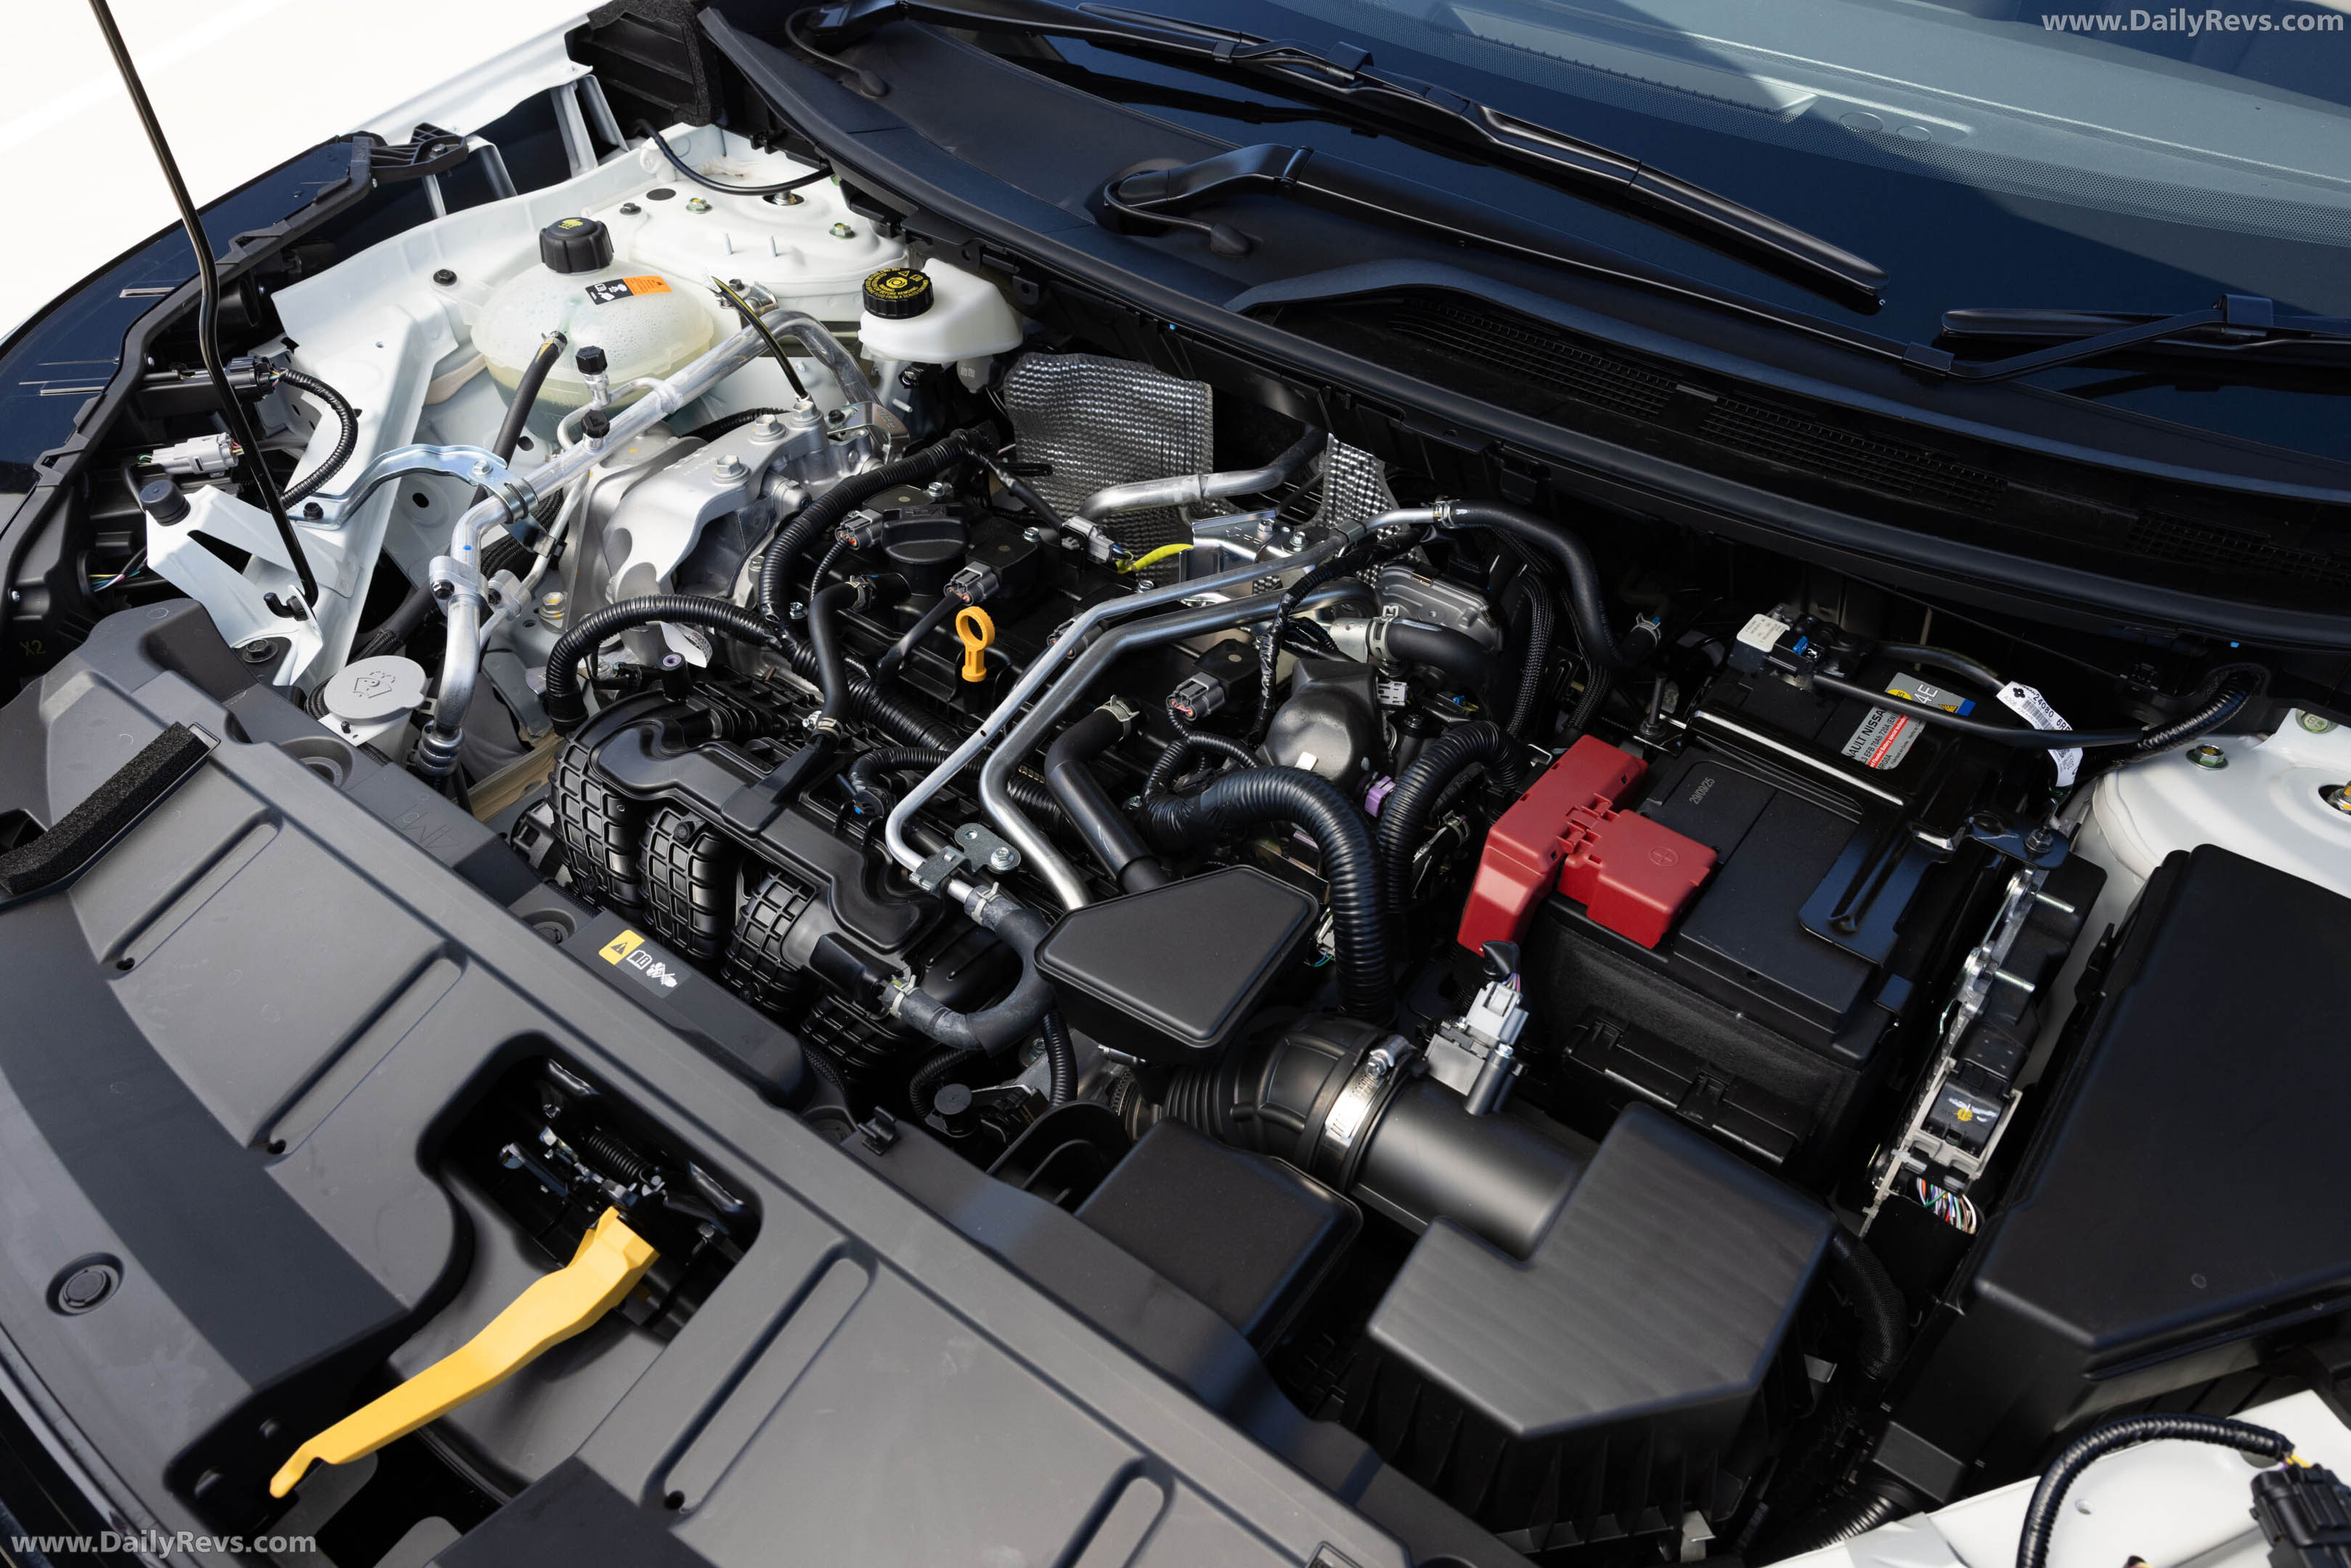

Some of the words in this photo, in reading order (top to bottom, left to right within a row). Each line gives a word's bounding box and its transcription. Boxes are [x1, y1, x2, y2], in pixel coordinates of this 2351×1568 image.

[1915, 684, 1938, 704] 4E
[2033, 693, 2054, 718] 24080
[1862, 709, 1886, 736] NISSA
[1689, 777, 1715, 804] 29/09/25
